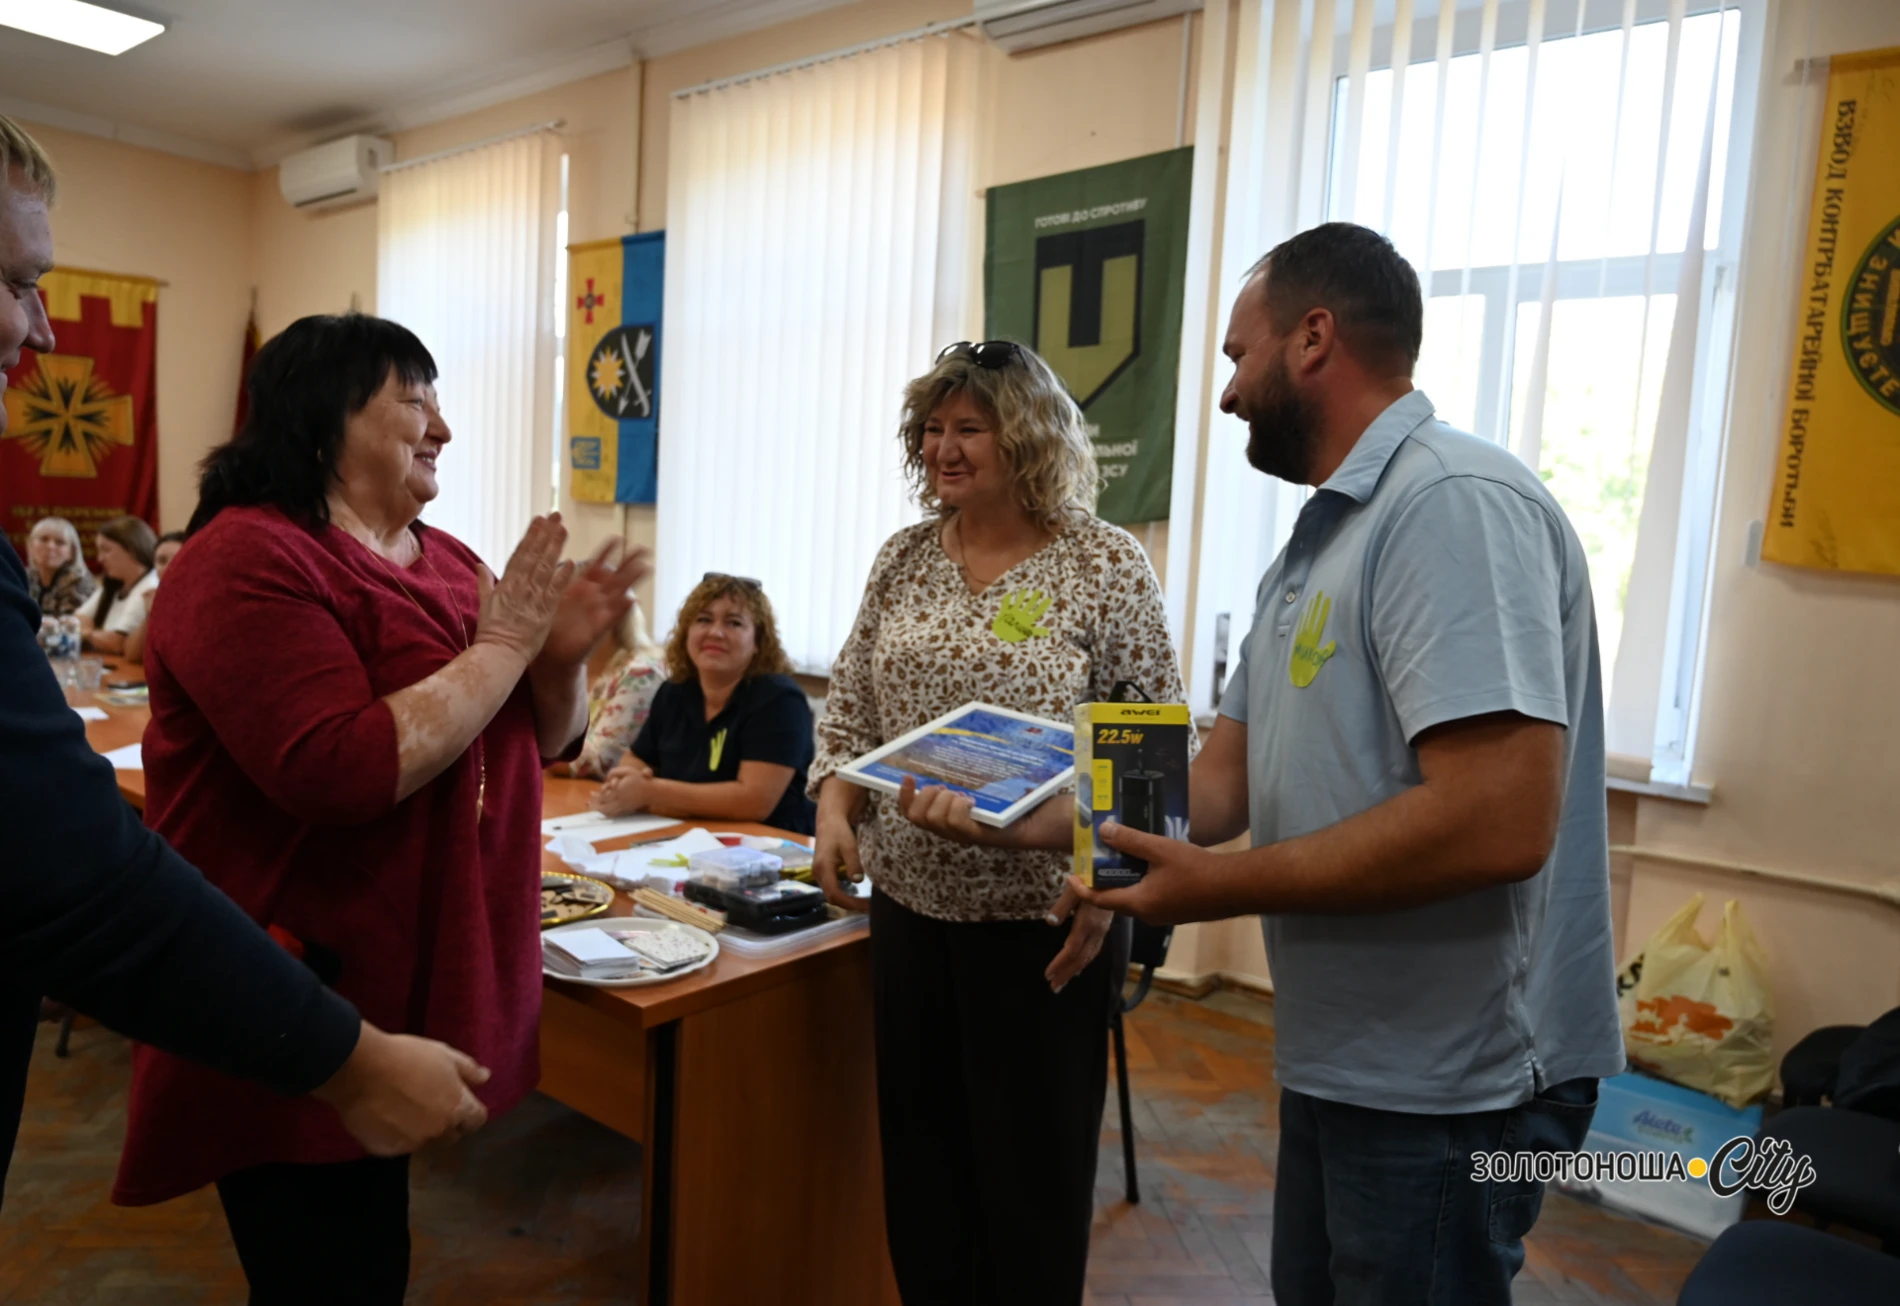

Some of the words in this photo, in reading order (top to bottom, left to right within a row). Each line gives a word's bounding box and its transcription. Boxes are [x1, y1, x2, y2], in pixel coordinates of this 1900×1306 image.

[1825, 98, 1857, 181] ВЗВОД
[1071, 209, 1089, 224] ДО
[1795, 187, 1845, 402] КОНТРБАТАРЕЙНОЇ
[1780, 407, 1810, 528] БОРОТЬБИ
